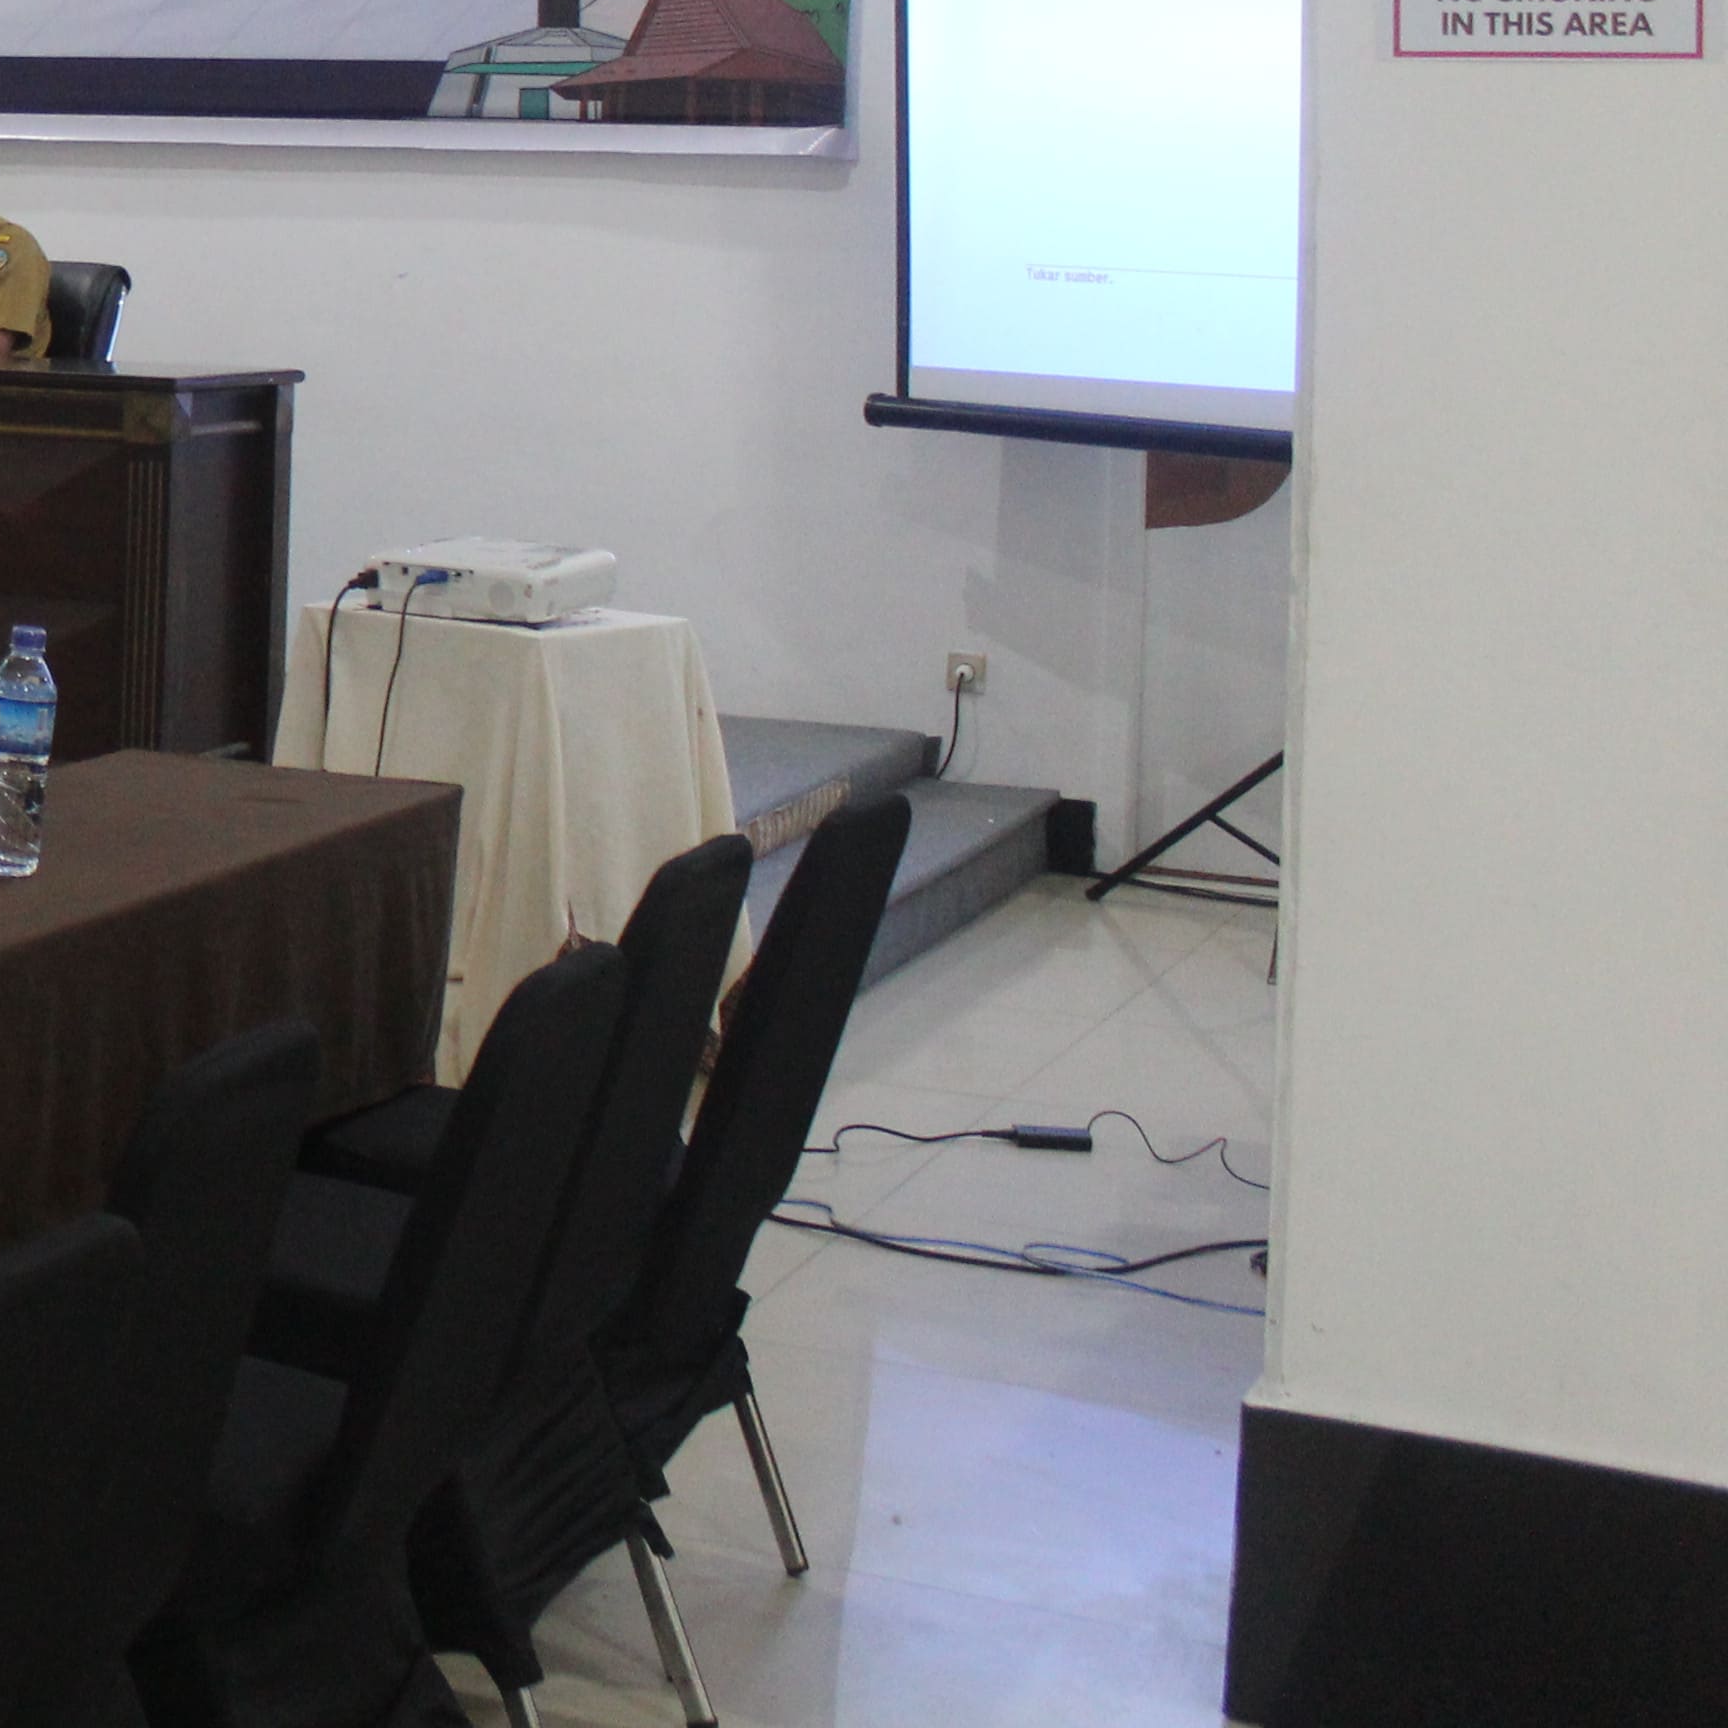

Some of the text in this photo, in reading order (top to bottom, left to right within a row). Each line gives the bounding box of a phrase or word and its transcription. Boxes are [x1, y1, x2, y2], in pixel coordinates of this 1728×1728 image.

[1441, 11, 1654, 36] IN THIS AREA
